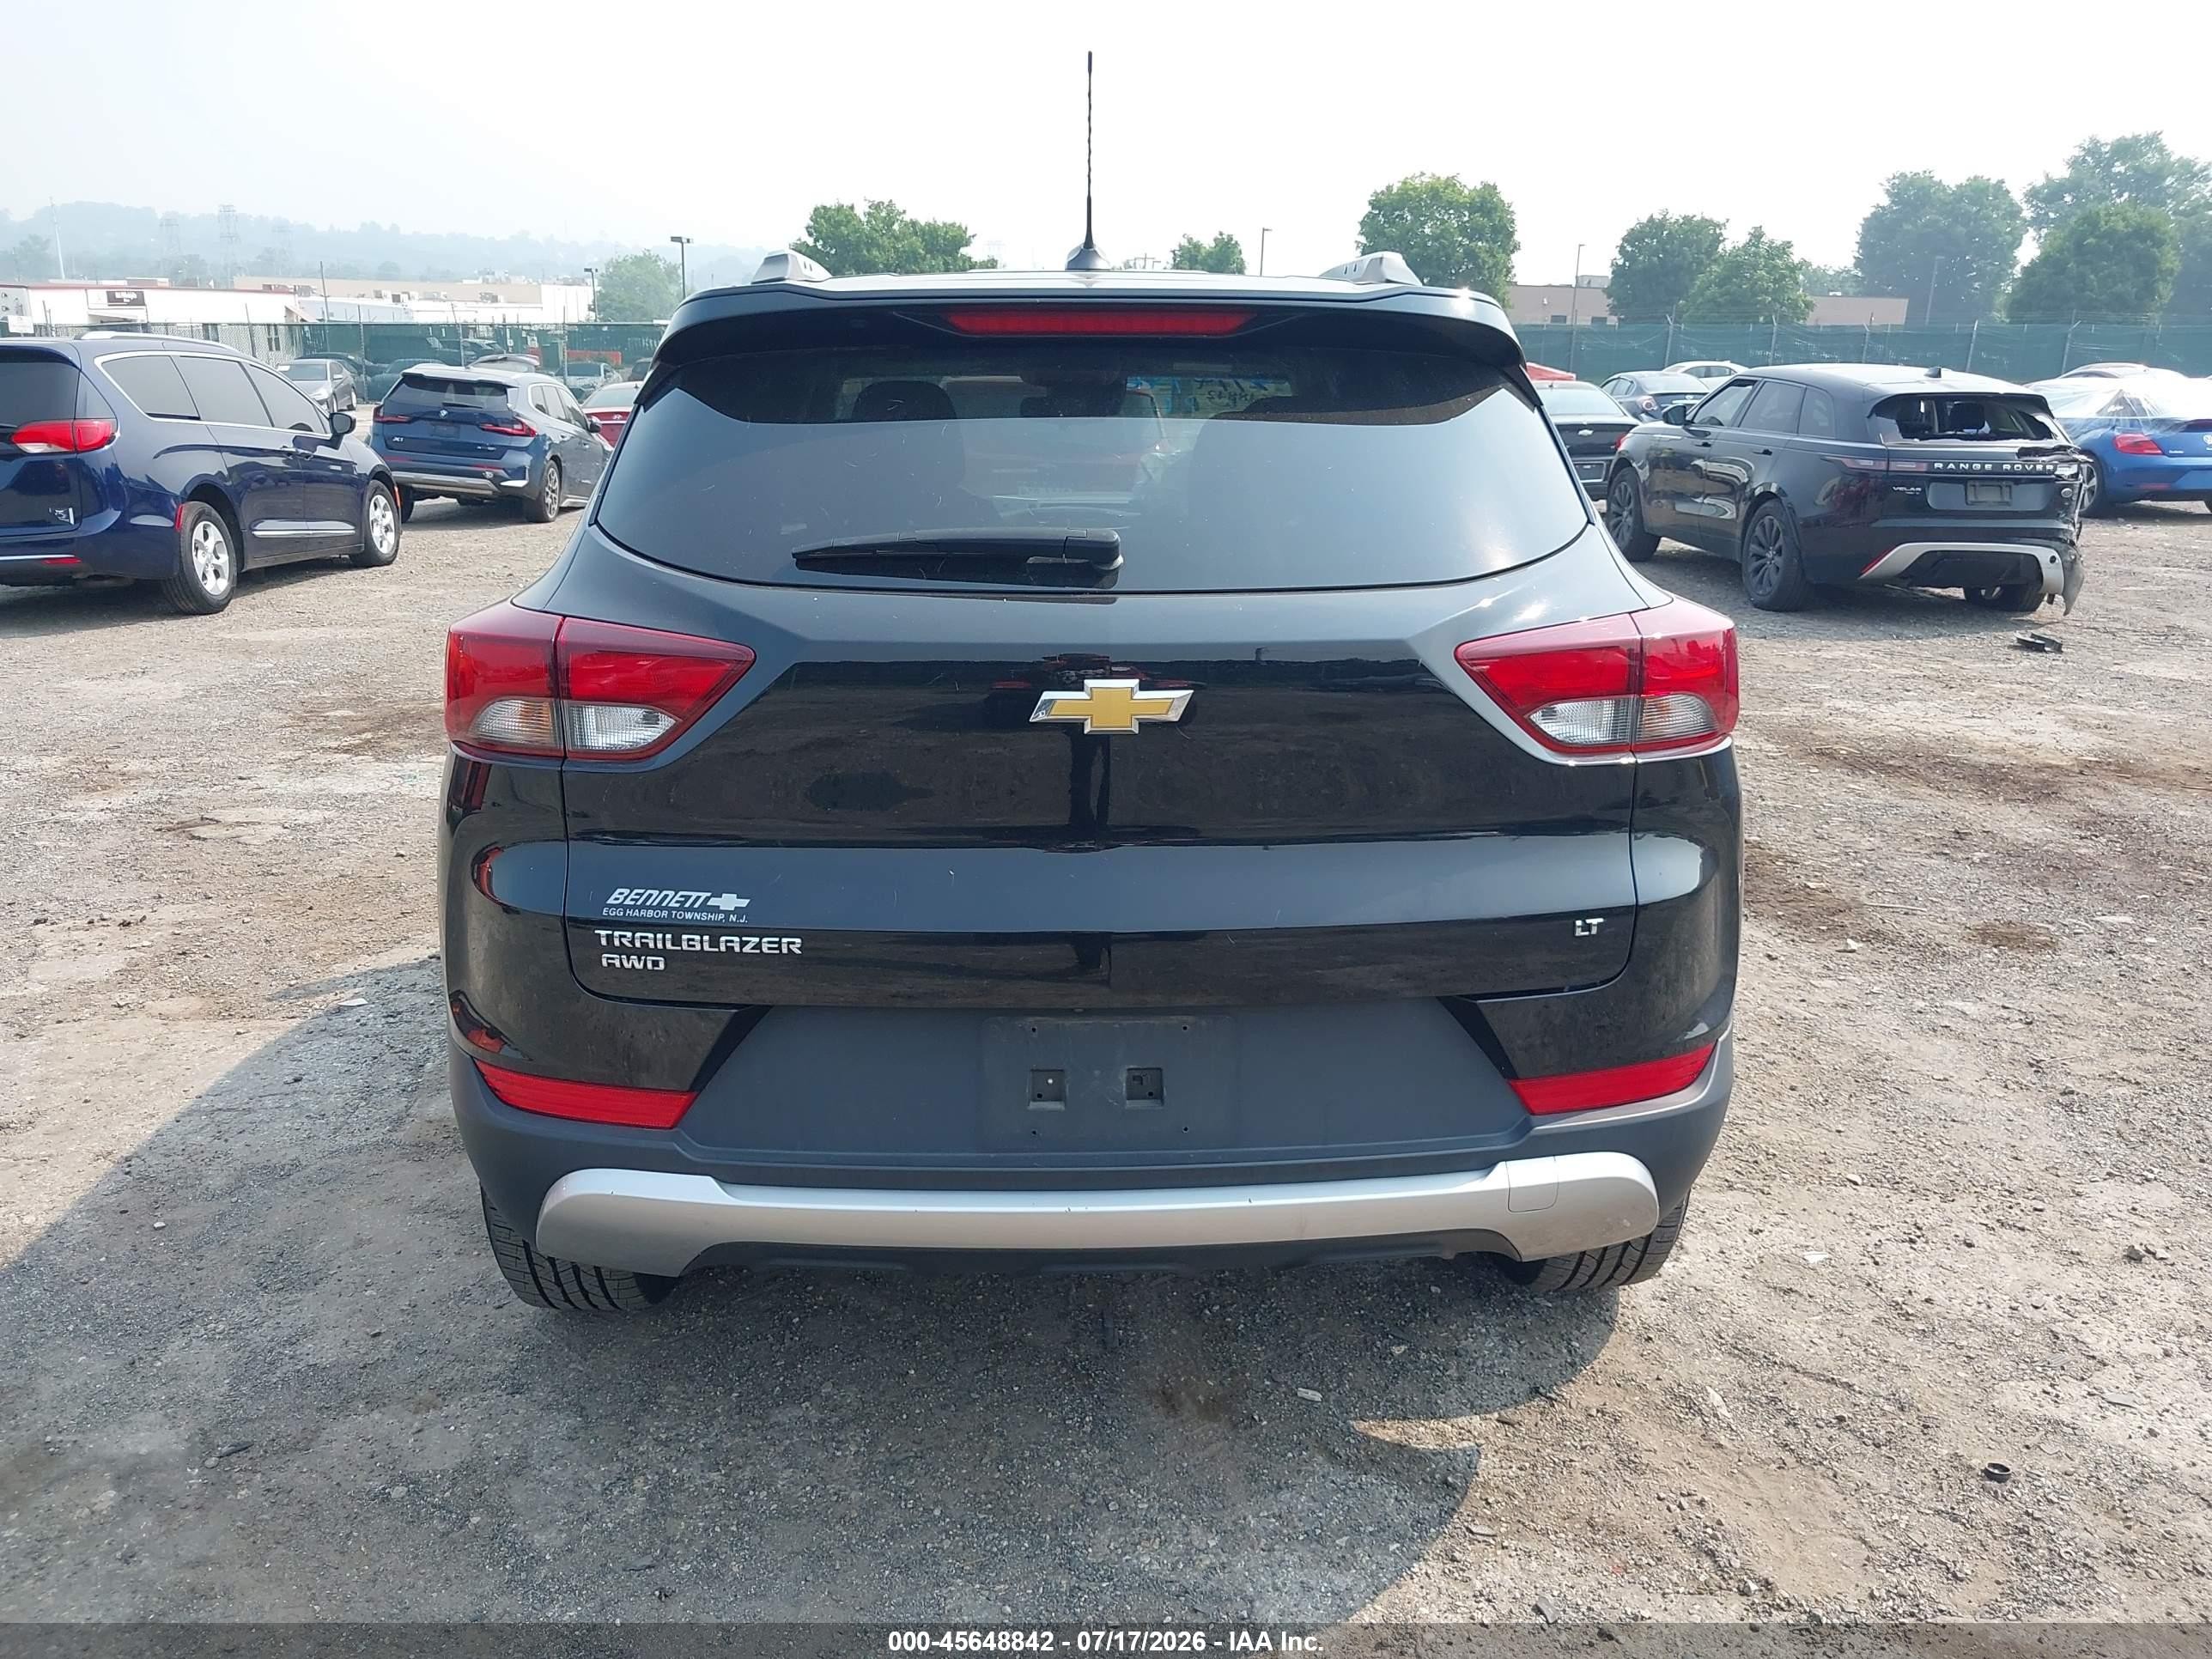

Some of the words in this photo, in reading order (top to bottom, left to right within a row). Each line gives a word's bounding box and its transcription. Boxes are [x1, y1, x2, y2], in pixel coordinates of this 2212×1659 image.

[606, 888, 712, 908] BENNETT
[602, 908, 624, 916] EGG
[625, 908, 668, 919] HARBOR
[671, 910, 726, 923] TOWNSHIP,
[729, 914, 748, 923] N.J.
[1575, 917, 1604, 936] LT
[594, 930, 803, 954] TRAILBLAZER
[601, 954, 665, 970] AWD
